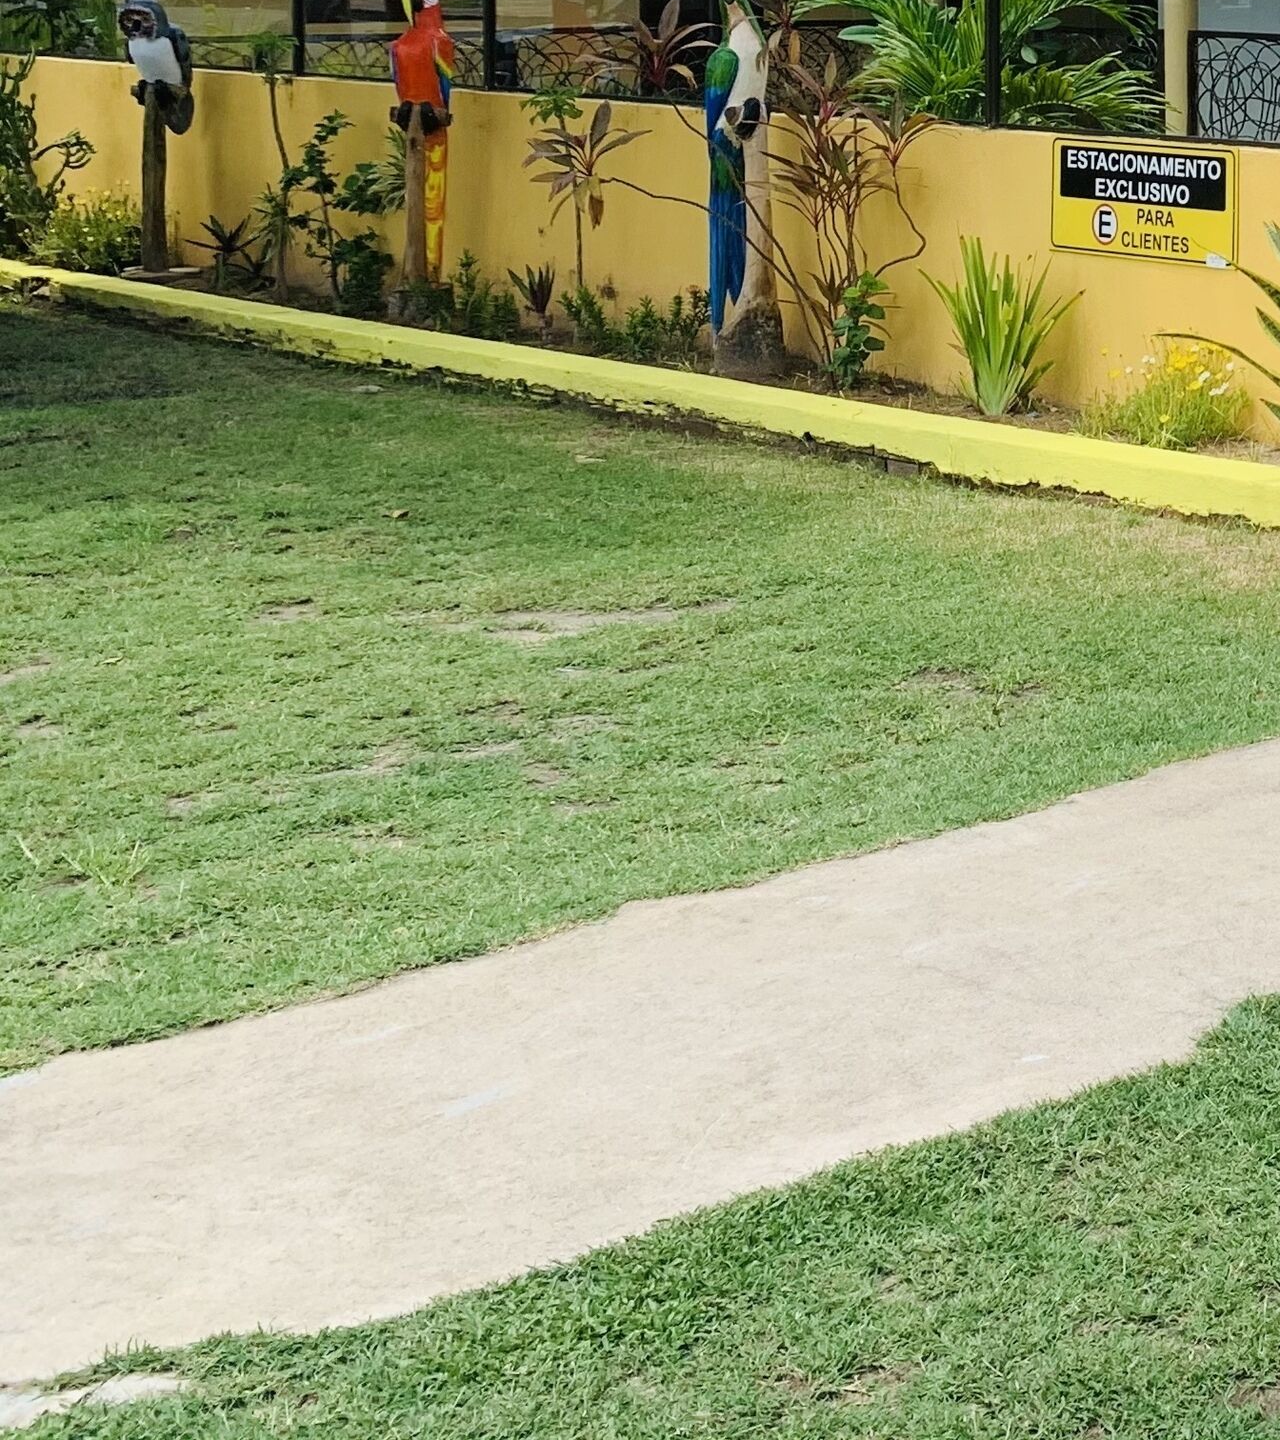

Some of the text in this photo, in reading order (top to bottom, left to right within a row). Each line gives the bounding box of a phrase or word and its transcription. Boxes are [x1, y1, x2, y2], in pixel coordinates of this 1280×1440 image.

[1067, 149, 1221, 180] ESTACIONAMENTO
[1094, 178, 1190, 205] EXCLUSIVO
[1098, 210, 1112, 238] E
[1136, 208, 1175, 228] PARA
[1121, 231, 1189, 254] CLIENTES
